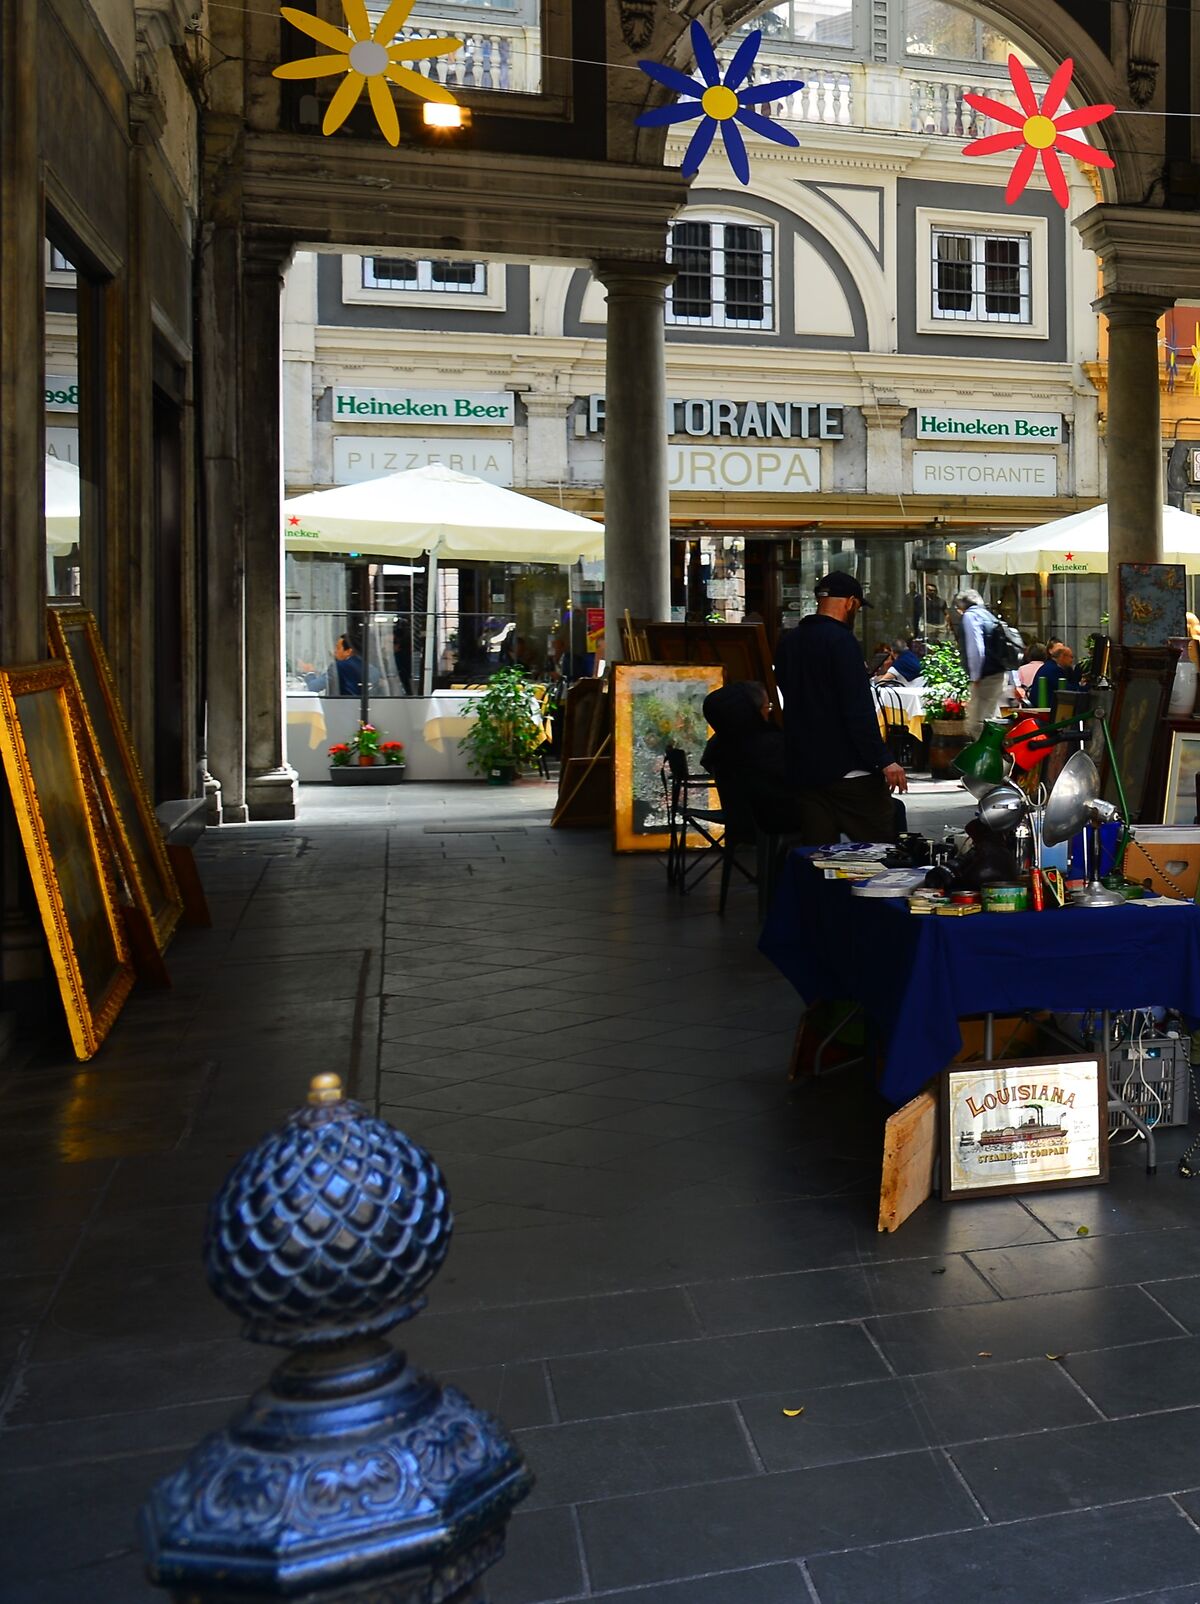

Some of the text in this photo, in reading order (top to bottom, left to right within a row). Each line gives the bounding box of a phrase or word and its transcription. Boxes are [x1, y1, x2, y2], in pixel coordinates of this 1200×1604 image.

[336, 395, 508, 418] Heineken Beer
[589, 393, 845, 440] RTORANTE
[920, 415, 1058, 437] Heineken Beer
[668, 451, 813, 486] UROPA
[924, 465, 1045, 484] RISTORANTE
[284, 528, 319, 538] ineken
[1052, 563, 1089, 572] Heineken
[965, 1084, 1077, 1118] LOUISIANA
[977, 1151, 1028, 1164] STEAMBOAT
[1030, 1146, 1069, 1158] COMPANY
